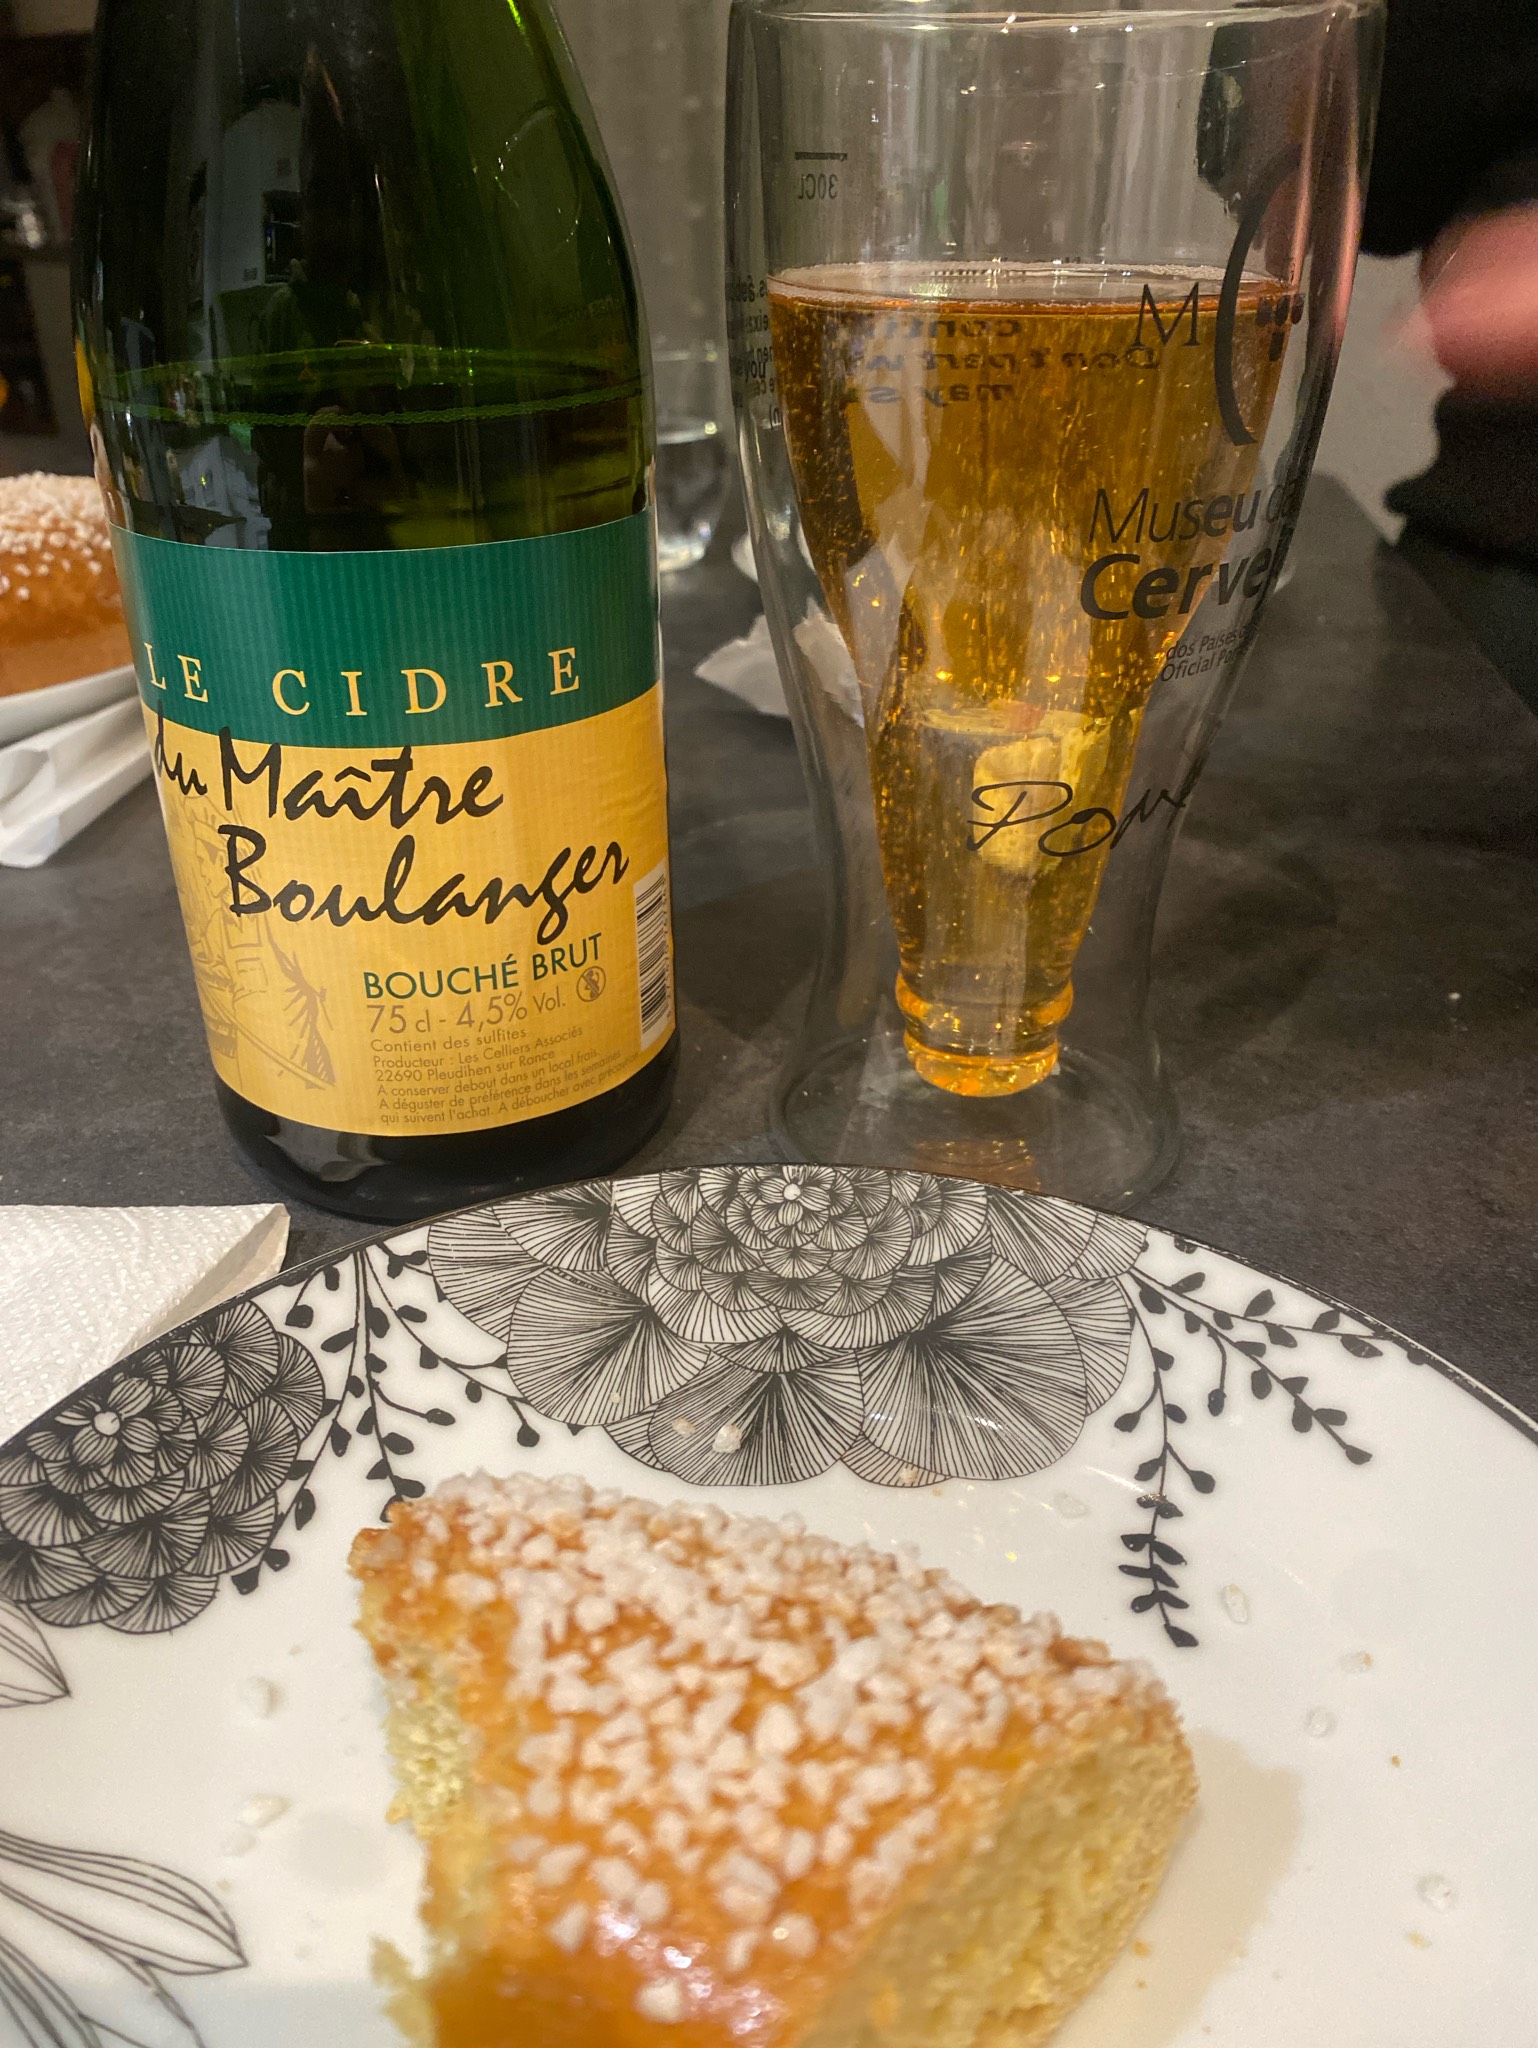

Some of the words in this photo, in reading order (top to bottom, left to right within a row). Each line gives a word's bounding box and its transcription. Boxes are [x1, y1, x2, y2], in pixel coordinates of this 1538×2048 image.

[1089, 487, 1261, 544] Museu
[144, 642, 209, 703] LE
[271, 647, 581, 717] CIDRE
[1160, 653, 1216, 682] Oficial
[155, 701, 208, 797] du
[217, 726, 504, 831] Maître
[217, 823, 631, 946] Boulanger
[363, 953, 519, 1000] BOUCHÉ
[531, 932, 603, 982] BRUT
[366, 1004, 408, 1034] 75
[455, 991, 529, 1034] 4,5%
[532, 985, 567, 1015] Vol.
[370, 1039, 438, 1053] Contient
[443, 1035, 470, 1050] des
[476, 1028, 527, 1047] sulfites
[373, 1055, 445, 1069] Producteur
[458, 1052, 479, 1065] Les
[483, 1044, 531, 1060] Celliers
[534, 1026, 583, 1049] Associés
[375, 1069, 423, 1082] 22690
[427, 1064, 492, 1081] Pleudihen
[496, 1060, 515, 1072] sur
[391, 1085, 449, 1097] conserver
[454, 1078, 497, 1094] debout
[500, 1072, 528, 1086] dans
[531, 1068, 545, 1079] un
[549, 1057, 574, 1073] local
[381, 1113, 400, 1126] qui
[404, 1111, 445, 1123] suivent
[512, 1085, 570, 1111] déboucher
[393, 1098, 445, 1113] déguster
[449, 1095, 465, 1107] de
[470, 1085, 531, 1107] préférence
[535, 1077, 562, 1092] dans
